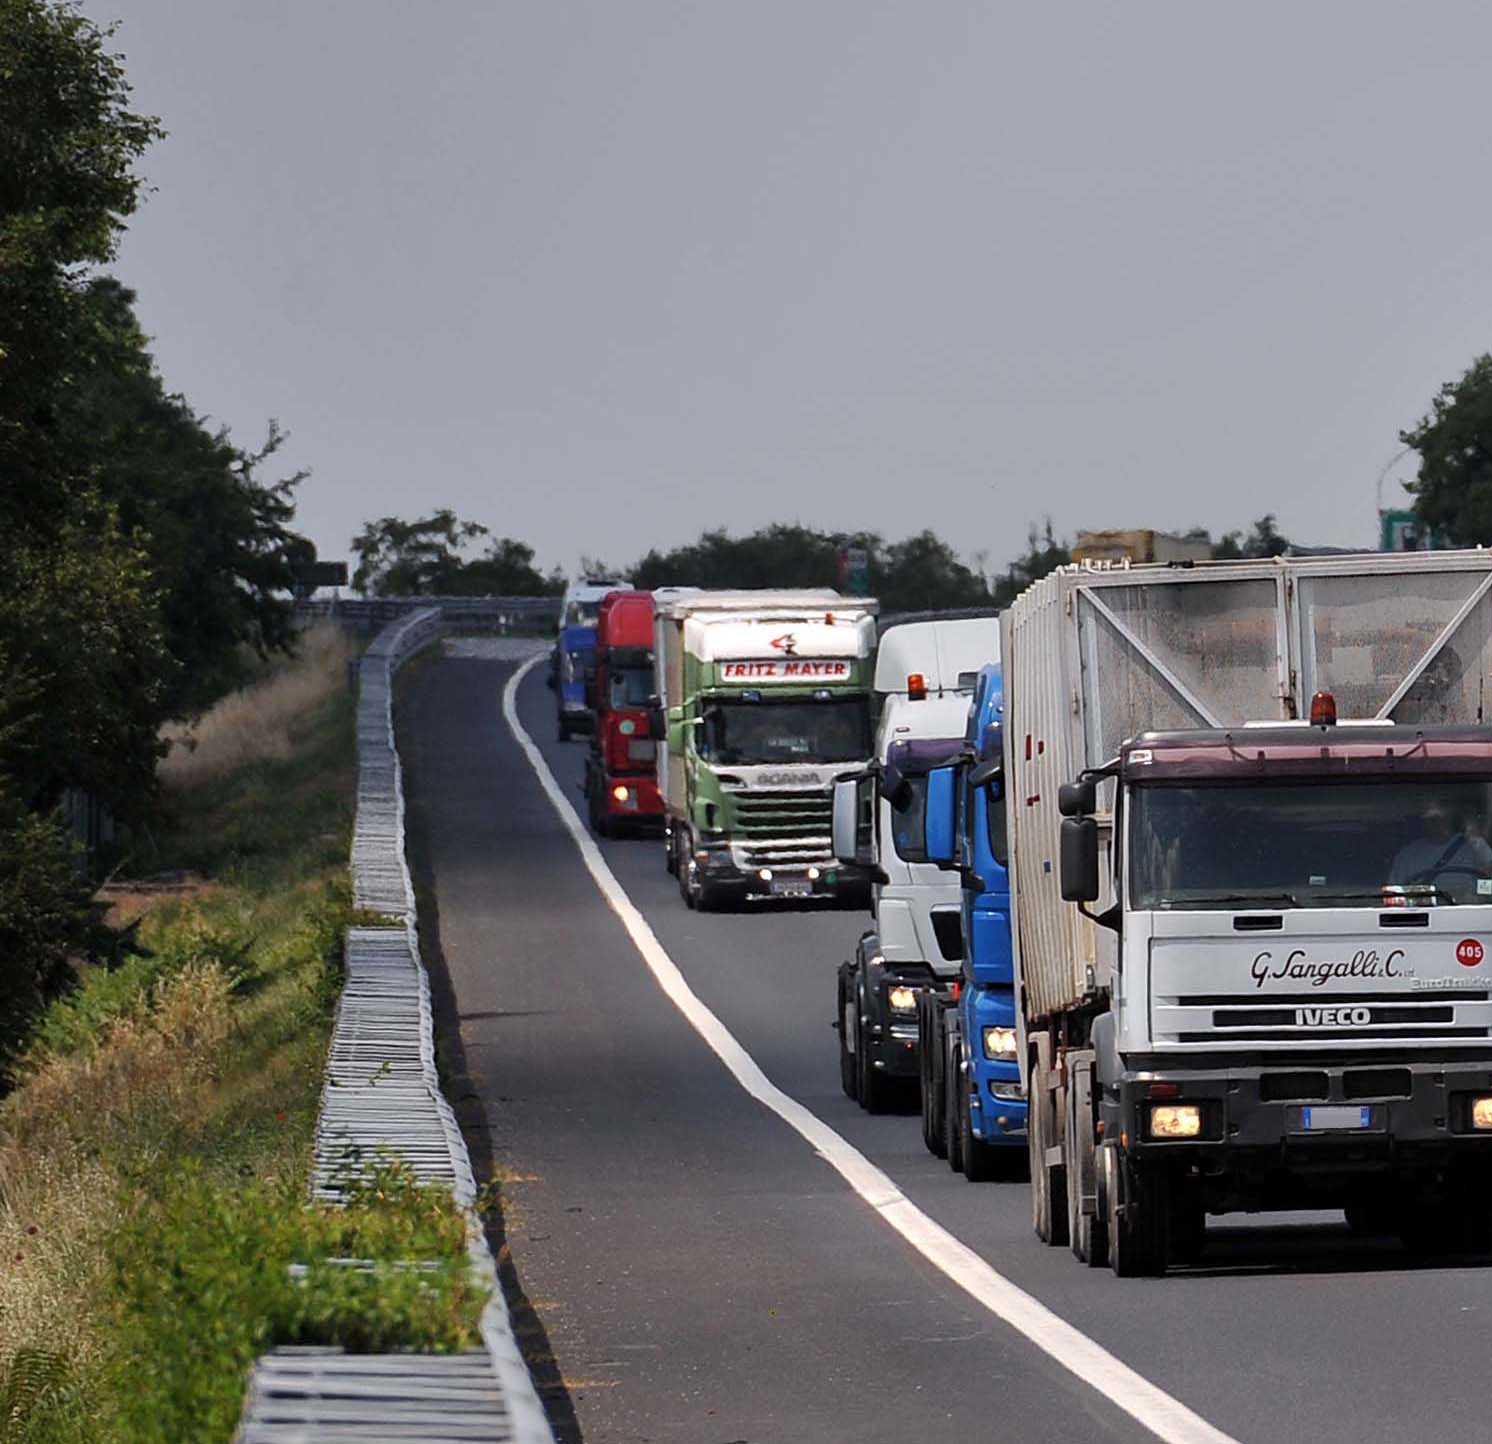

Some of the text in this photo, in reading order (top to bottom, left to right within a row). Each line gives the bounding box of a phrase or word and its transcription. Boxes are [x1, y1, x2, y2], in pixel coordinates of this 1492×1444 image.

[724, 663, 846, 677] FRITZ MAYER
[1458, 946, 1482, 958] 405
[1295, 1008, 1371, 1026] IVECO
